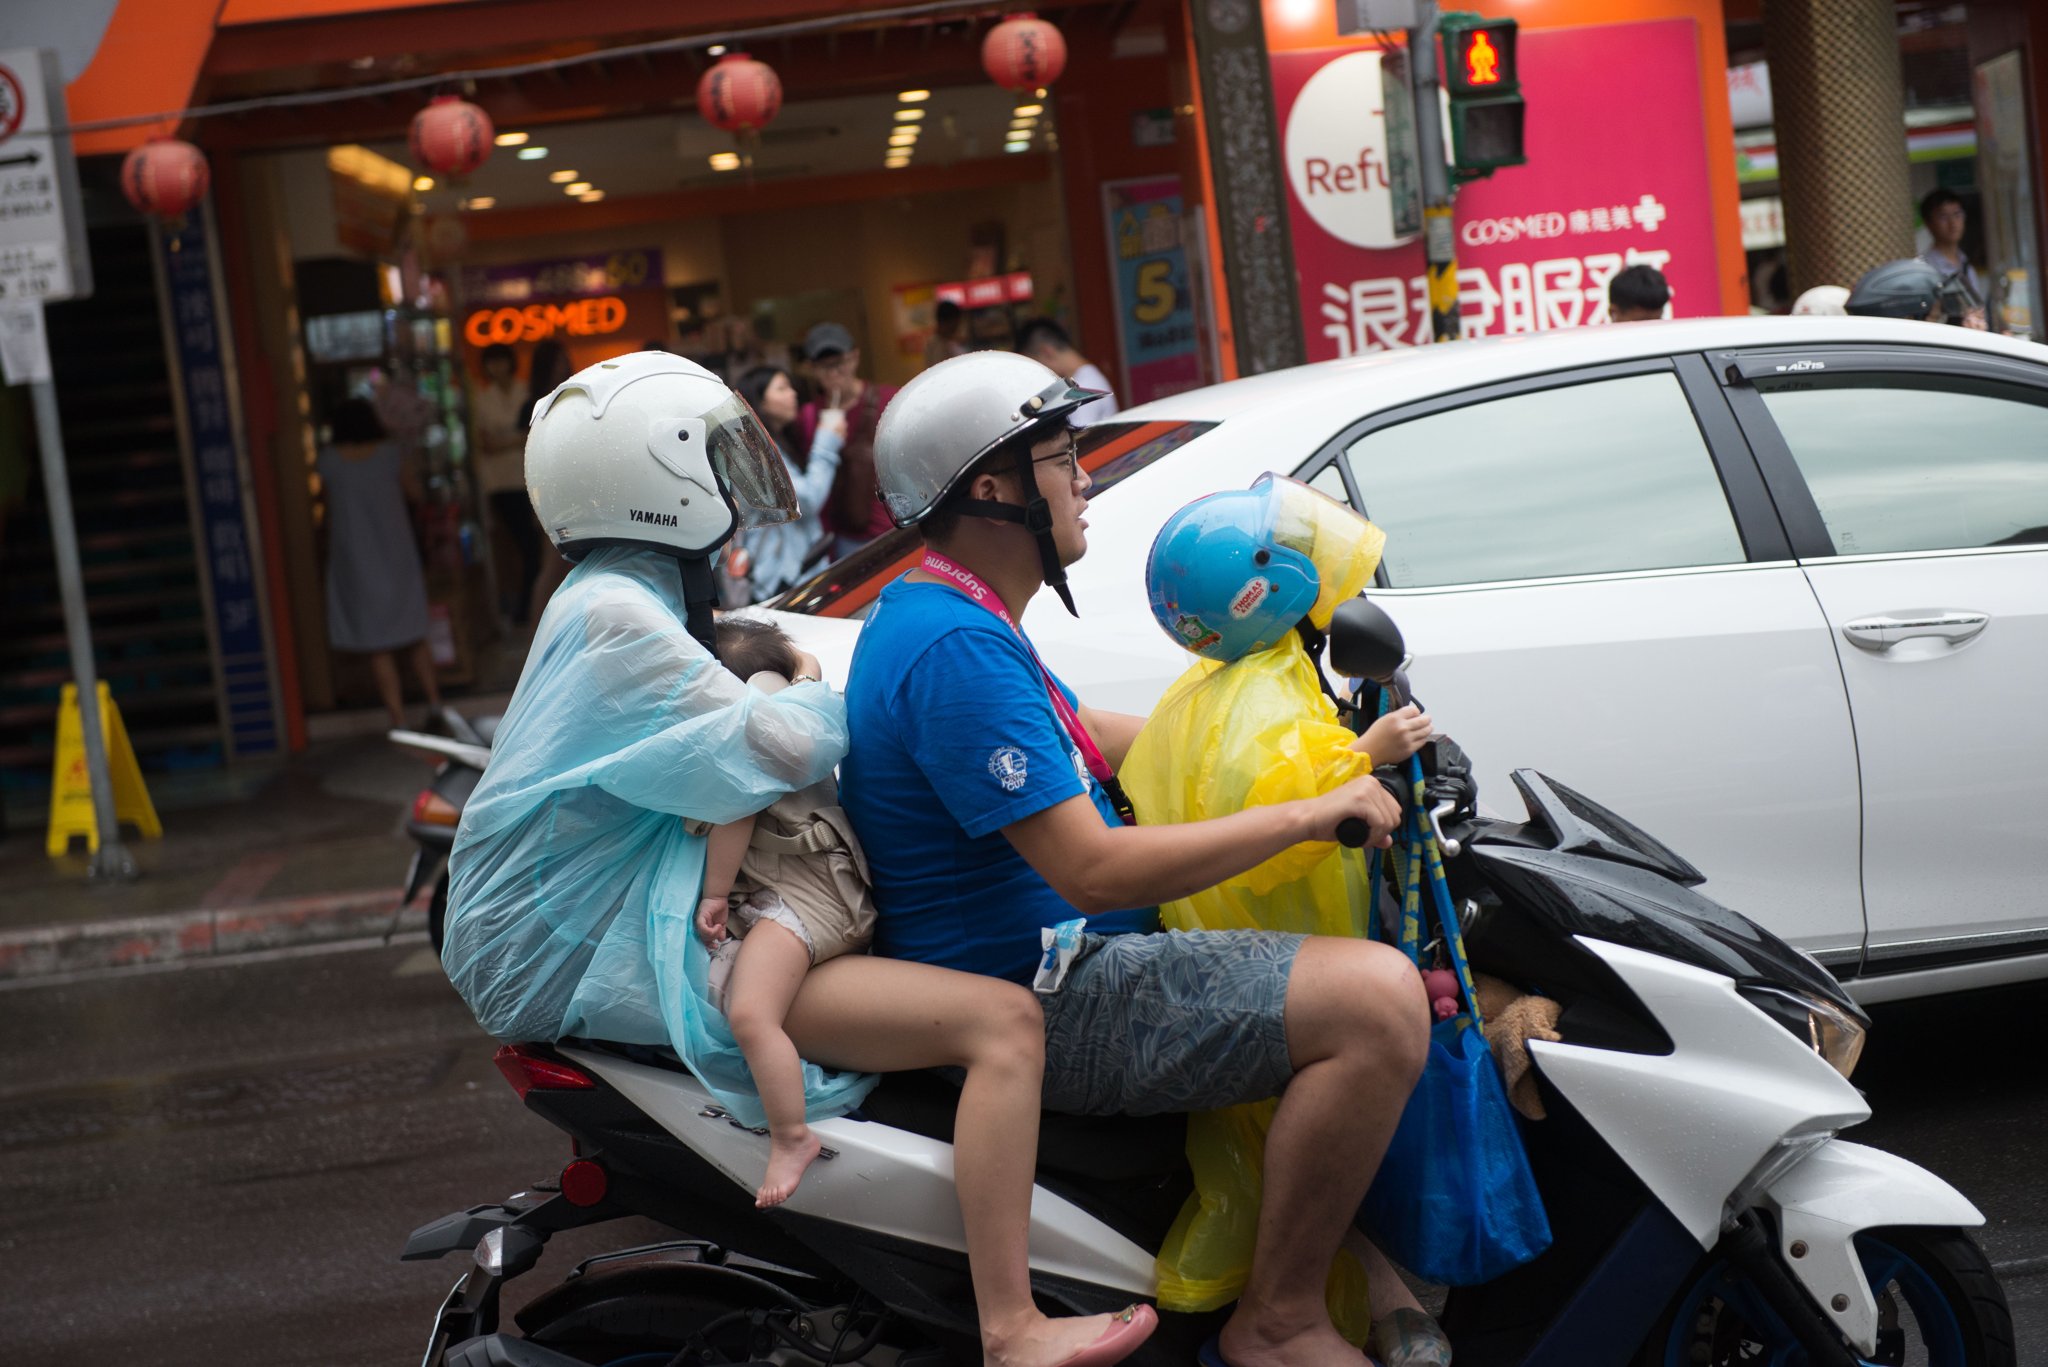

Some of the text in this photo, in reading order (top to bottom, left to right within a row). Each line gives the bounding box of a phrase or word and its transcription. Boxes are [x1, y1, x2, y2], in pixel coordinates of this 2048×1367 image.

[1305, 149, 1390, 196] Refu
[1462, 212, 1566, 246] COSMED
[465, 297, 627, 347] COSMED
[1788, 360, 1825, 371] ALTIS
[630, 508, 678, 527] YAMAHA
[924, 555, 988, 600] Supreme
[1233, 581, 1262, 611] THOMAS
[1007, 777, 1026, 791] CUP
[1402, 841, 1422, 943] IKEA
